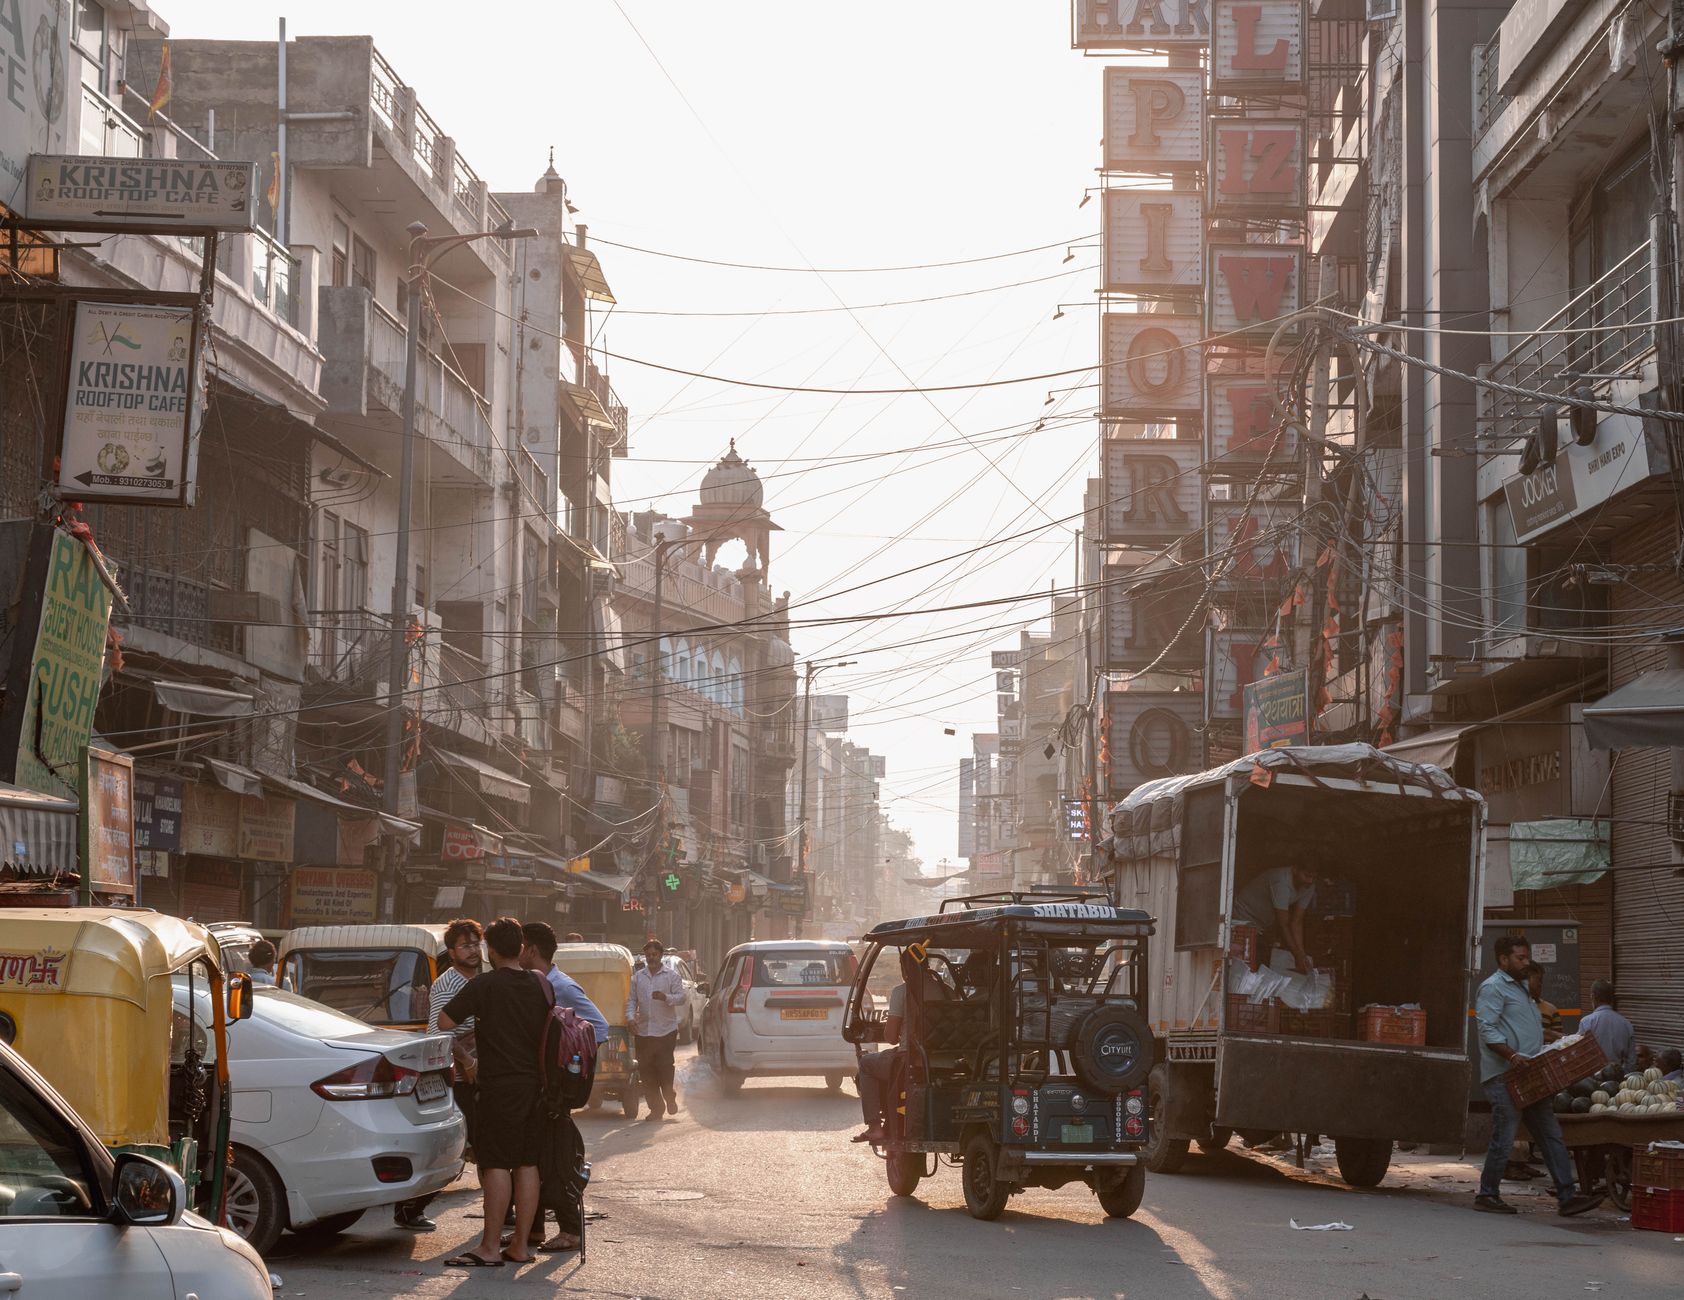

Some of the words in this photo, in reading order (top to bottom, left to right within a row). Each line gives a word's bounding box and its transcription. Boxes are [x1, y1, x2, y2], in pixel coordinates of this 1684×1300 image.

[59, 165, 219, 192] KRISHNA
[58, 187, 158, 202] ROOFTOP
[166, 190, 219, 205] CAFE
[78, 360, 187, 393] KRISHNA
[75, 390, 145, 410] ROOFTOP
[148, 394, 186, 413] CAFE
[1521, 463, 1558, 509] JOCKEY
[44, 597, 77, 642] GUEST
[75, 612, 105, 658] HOUSE
[1033, 904, 1118, 919] SHATABDI
